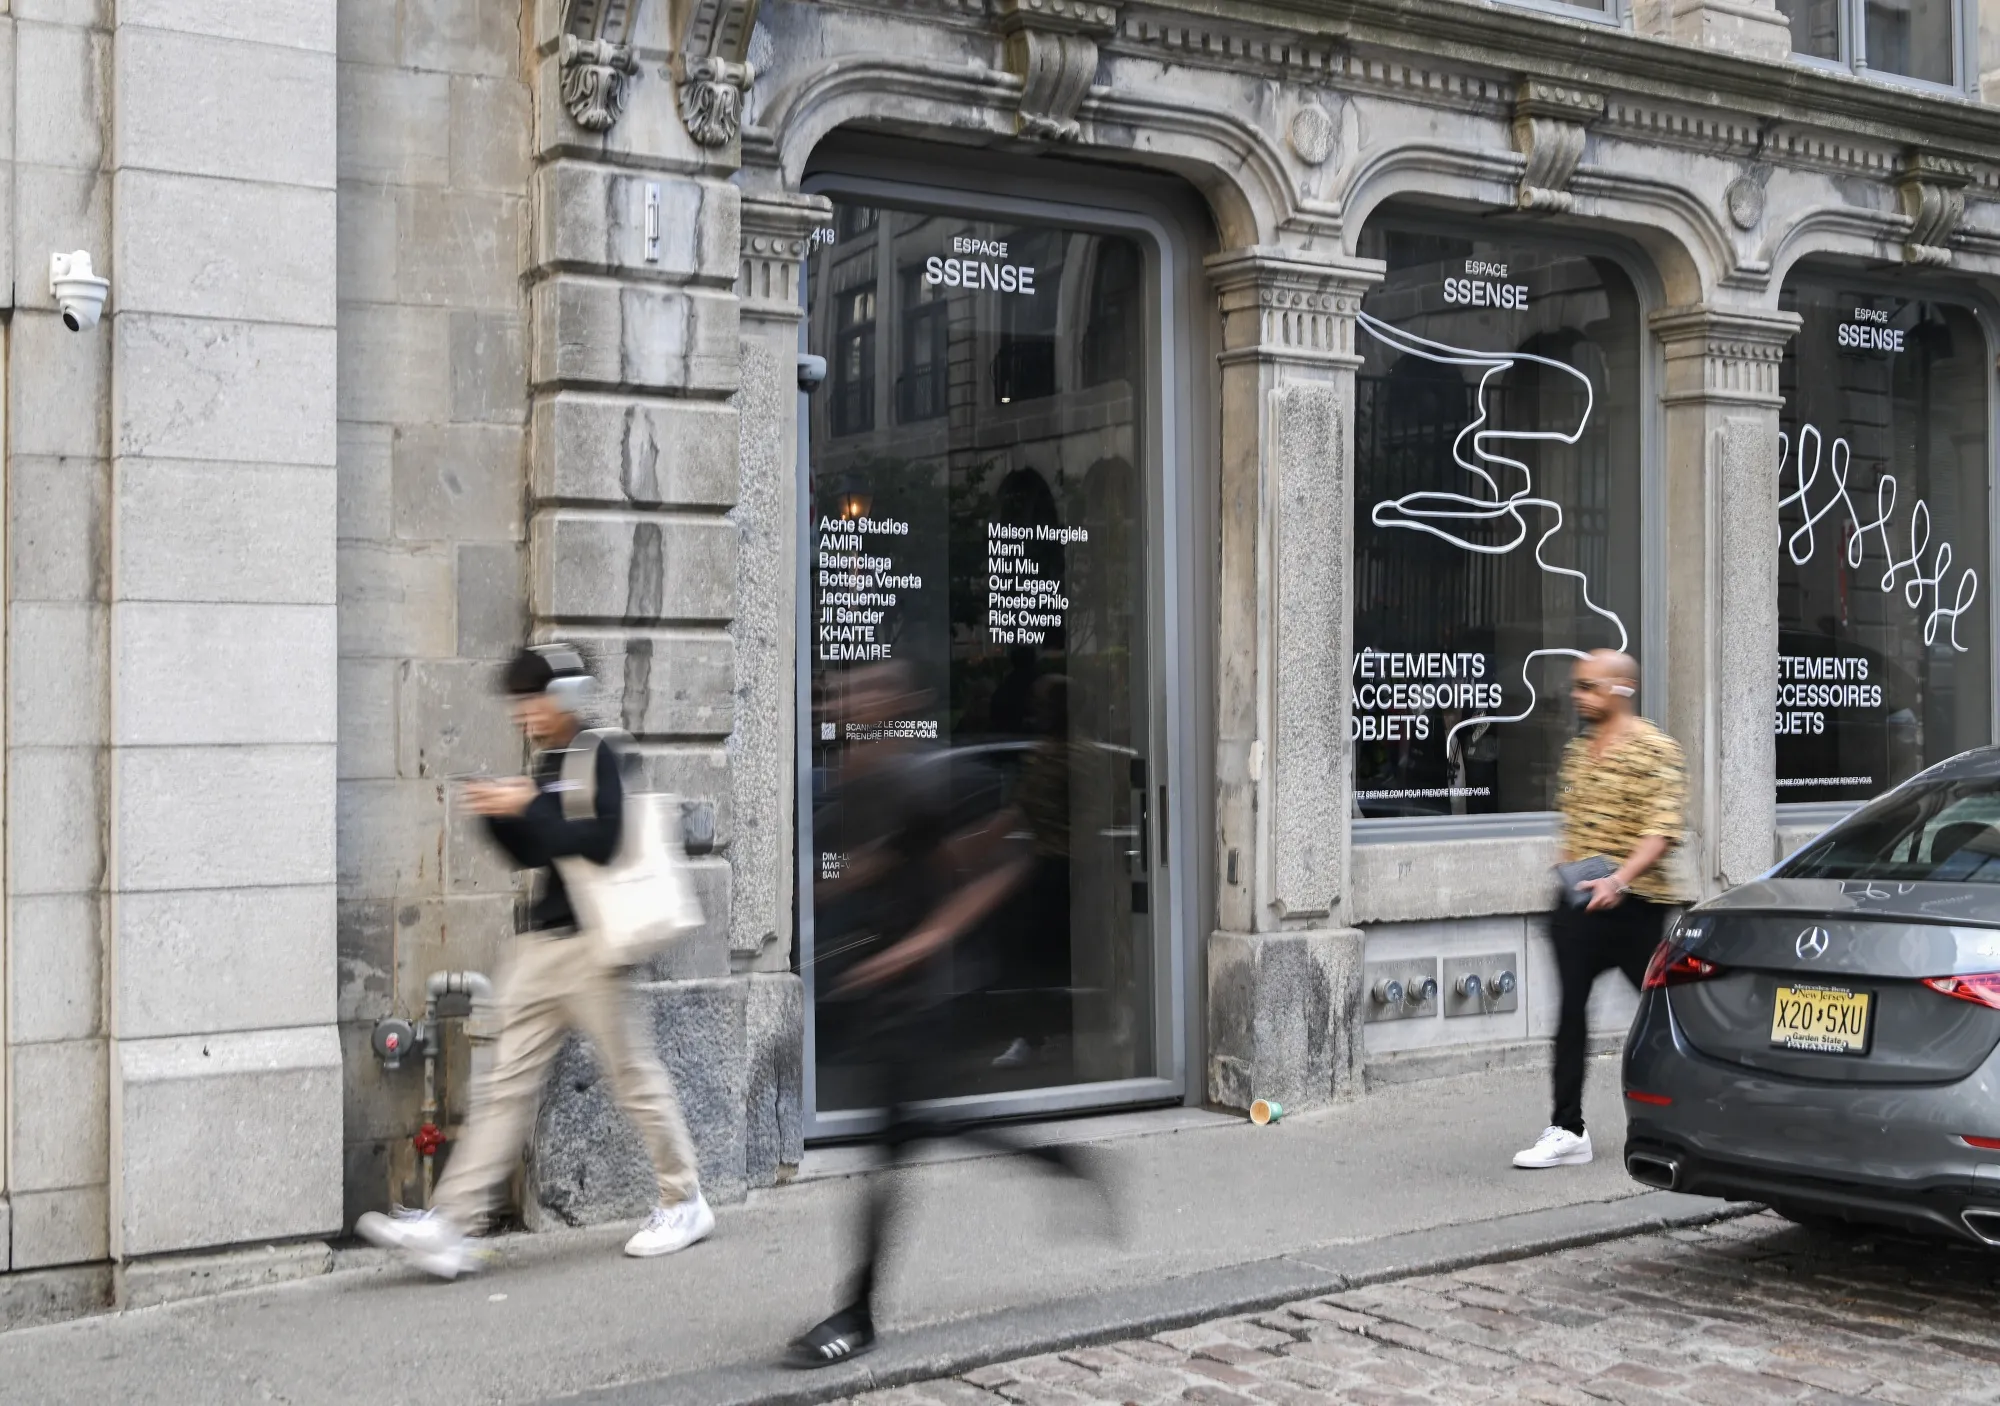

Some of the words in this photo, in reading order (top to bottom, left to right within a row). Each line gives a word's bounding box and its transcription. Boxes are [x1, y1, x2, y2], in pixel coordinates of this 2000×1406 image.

[811, 227, 835, 245] 418
[953, 236, 1008, 258] ESPACE
[925, 256, 1035, 295] SSENSE
[1465, 259, 1508, 278] ESPACE
[1443, 277, 1529, 311] SSENSE
[1854, 307, 1888, 325] ESPACE
[1838, 323, 1904, 352] SSENSE
[819, 515, 855, 533] Acne
[857, 516, 909, 536] Studios
[988, 522, 1033, 540] Maison
[1036, 524, 1089, 545] Margiela
[819, 533, 863, 552] AMIRI
[988, 540, 1024, 557] Marni
[819, 551, 892, 574] Balenciaga
[988, 557, 1012, 574] Miu
[1015, 558, 1039, 575] Miu
[819, 569, 873, 592] Bottega
[874, 570, 922, 589] Veneta
[988, 574, 1013, 592] Our
[1015, 575, 1060, 596] Legacy
[819, 588, 896, 609] Jacquemus
[988, 592, 1036, 610] Phoebe
[1038, 593, 1069, 611] Philo
[819, 606, 833, 624] Jil
[836, 607, 884, 625] Sander
[988, 609, 1017, 627] Rick
[1018, 610, 1062, 628] Owens
[819, 625, 875, 642] KHAITE
[988, 627, 1014, 644] The
[1017, 628, 1045, 645] Row
[819, 643, 892, 661] LEMAIRE
[883, 720, 894, 729] LE
[894, 720, 916, 730] CODE
[916, 720, 938, 731] POUR
[1804, 777, 1818, 787] POUR
[1818, 777, 1840, 786] PRENDRE
[1365, 789, 1404, 800] SSENSE.COM
[1404, 788, 1421, 799] POUR
[1421, 787, 1449, 798] PRENDRE
[1794, 984, 1850, 993] Mercedes-Benz
[1797, 989, 1817, 999] New
[1818, 990, 1847, 1003] Jersey
[1777, 999, 1813, 1030] X20
[1825, 1003, 1863, 1035] SXU
[1787, 1040, 1844, 1052] PARAMUS
[1792, 1031, 1819, 1043] Garden
[1821, 1034, 1842, 1045] State
